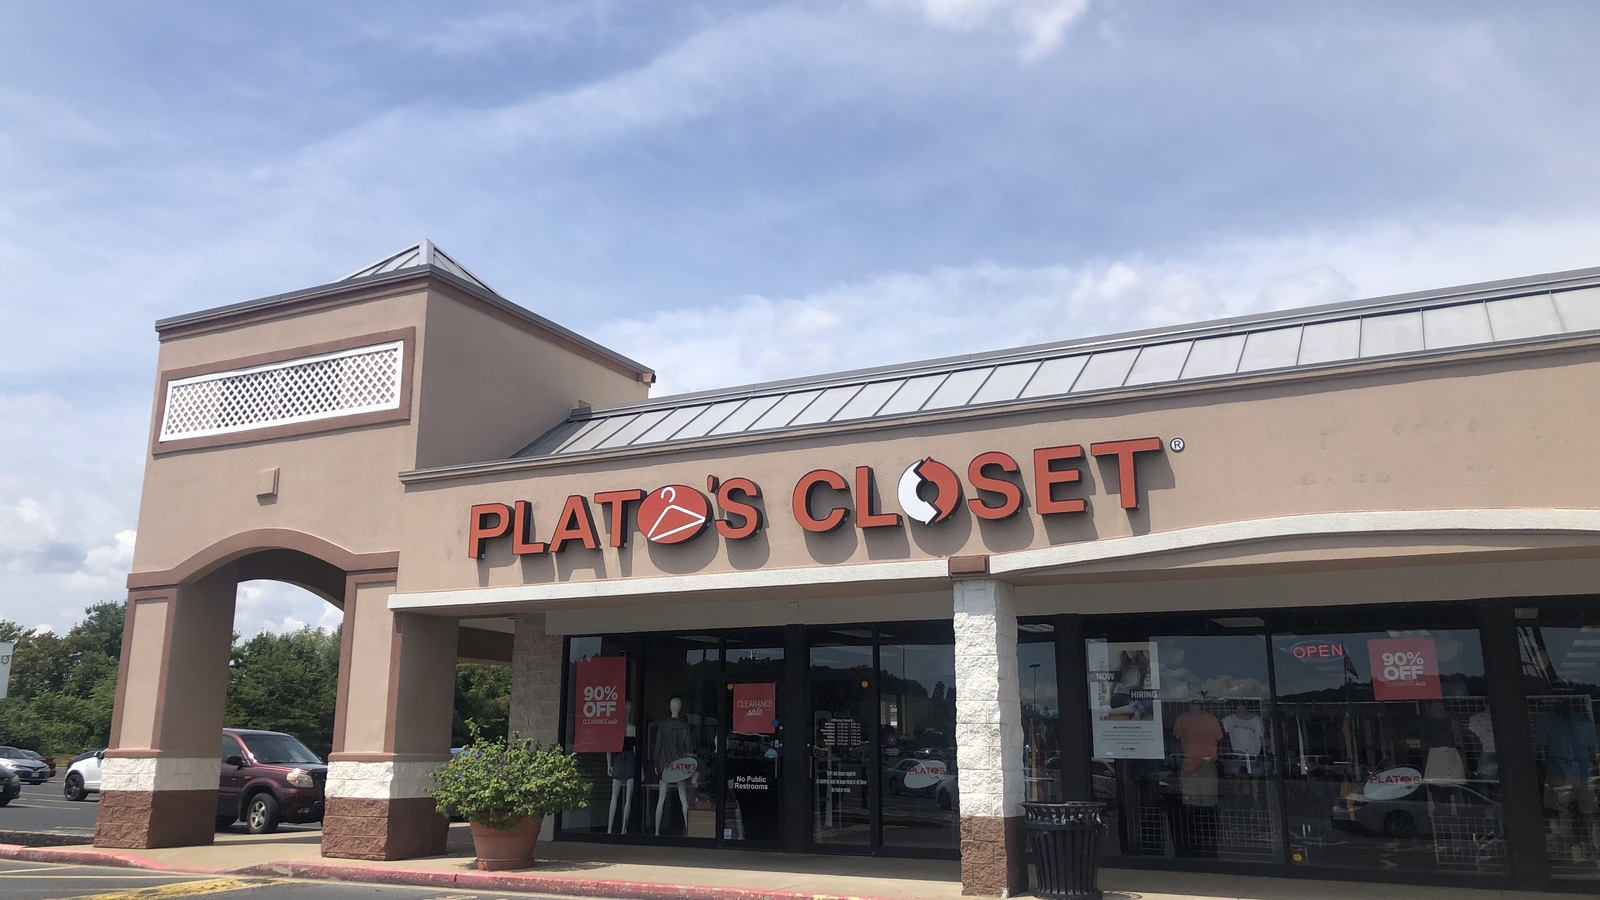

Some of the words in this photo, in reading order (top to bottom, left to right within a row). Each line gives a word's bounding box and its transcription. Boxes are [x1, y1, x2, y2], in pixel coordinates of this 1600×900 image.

[468, 475, 763, 559] PLATO'S
[792, 437, 1164, 532] CLOSET
[1293, 644, 1343, 659] OPEN
[1382, 651, 1425, 666] 90%
[1096, 672, 1115, 681] NOW
[1383, 665, 1424, 680] OFF
[583, 685, 618, 701] 90%
[1130, 690, 1158, 699] HIRING
[583, 701, 617, 718] OFF
[737, 700, 773, 708] CLEARANCE
[746, 707, 763, 716] sale
[736, 775, 746, 783] No
[746, 775, 767, 783] Public
[734, 782, 769, 790] Restrooms
